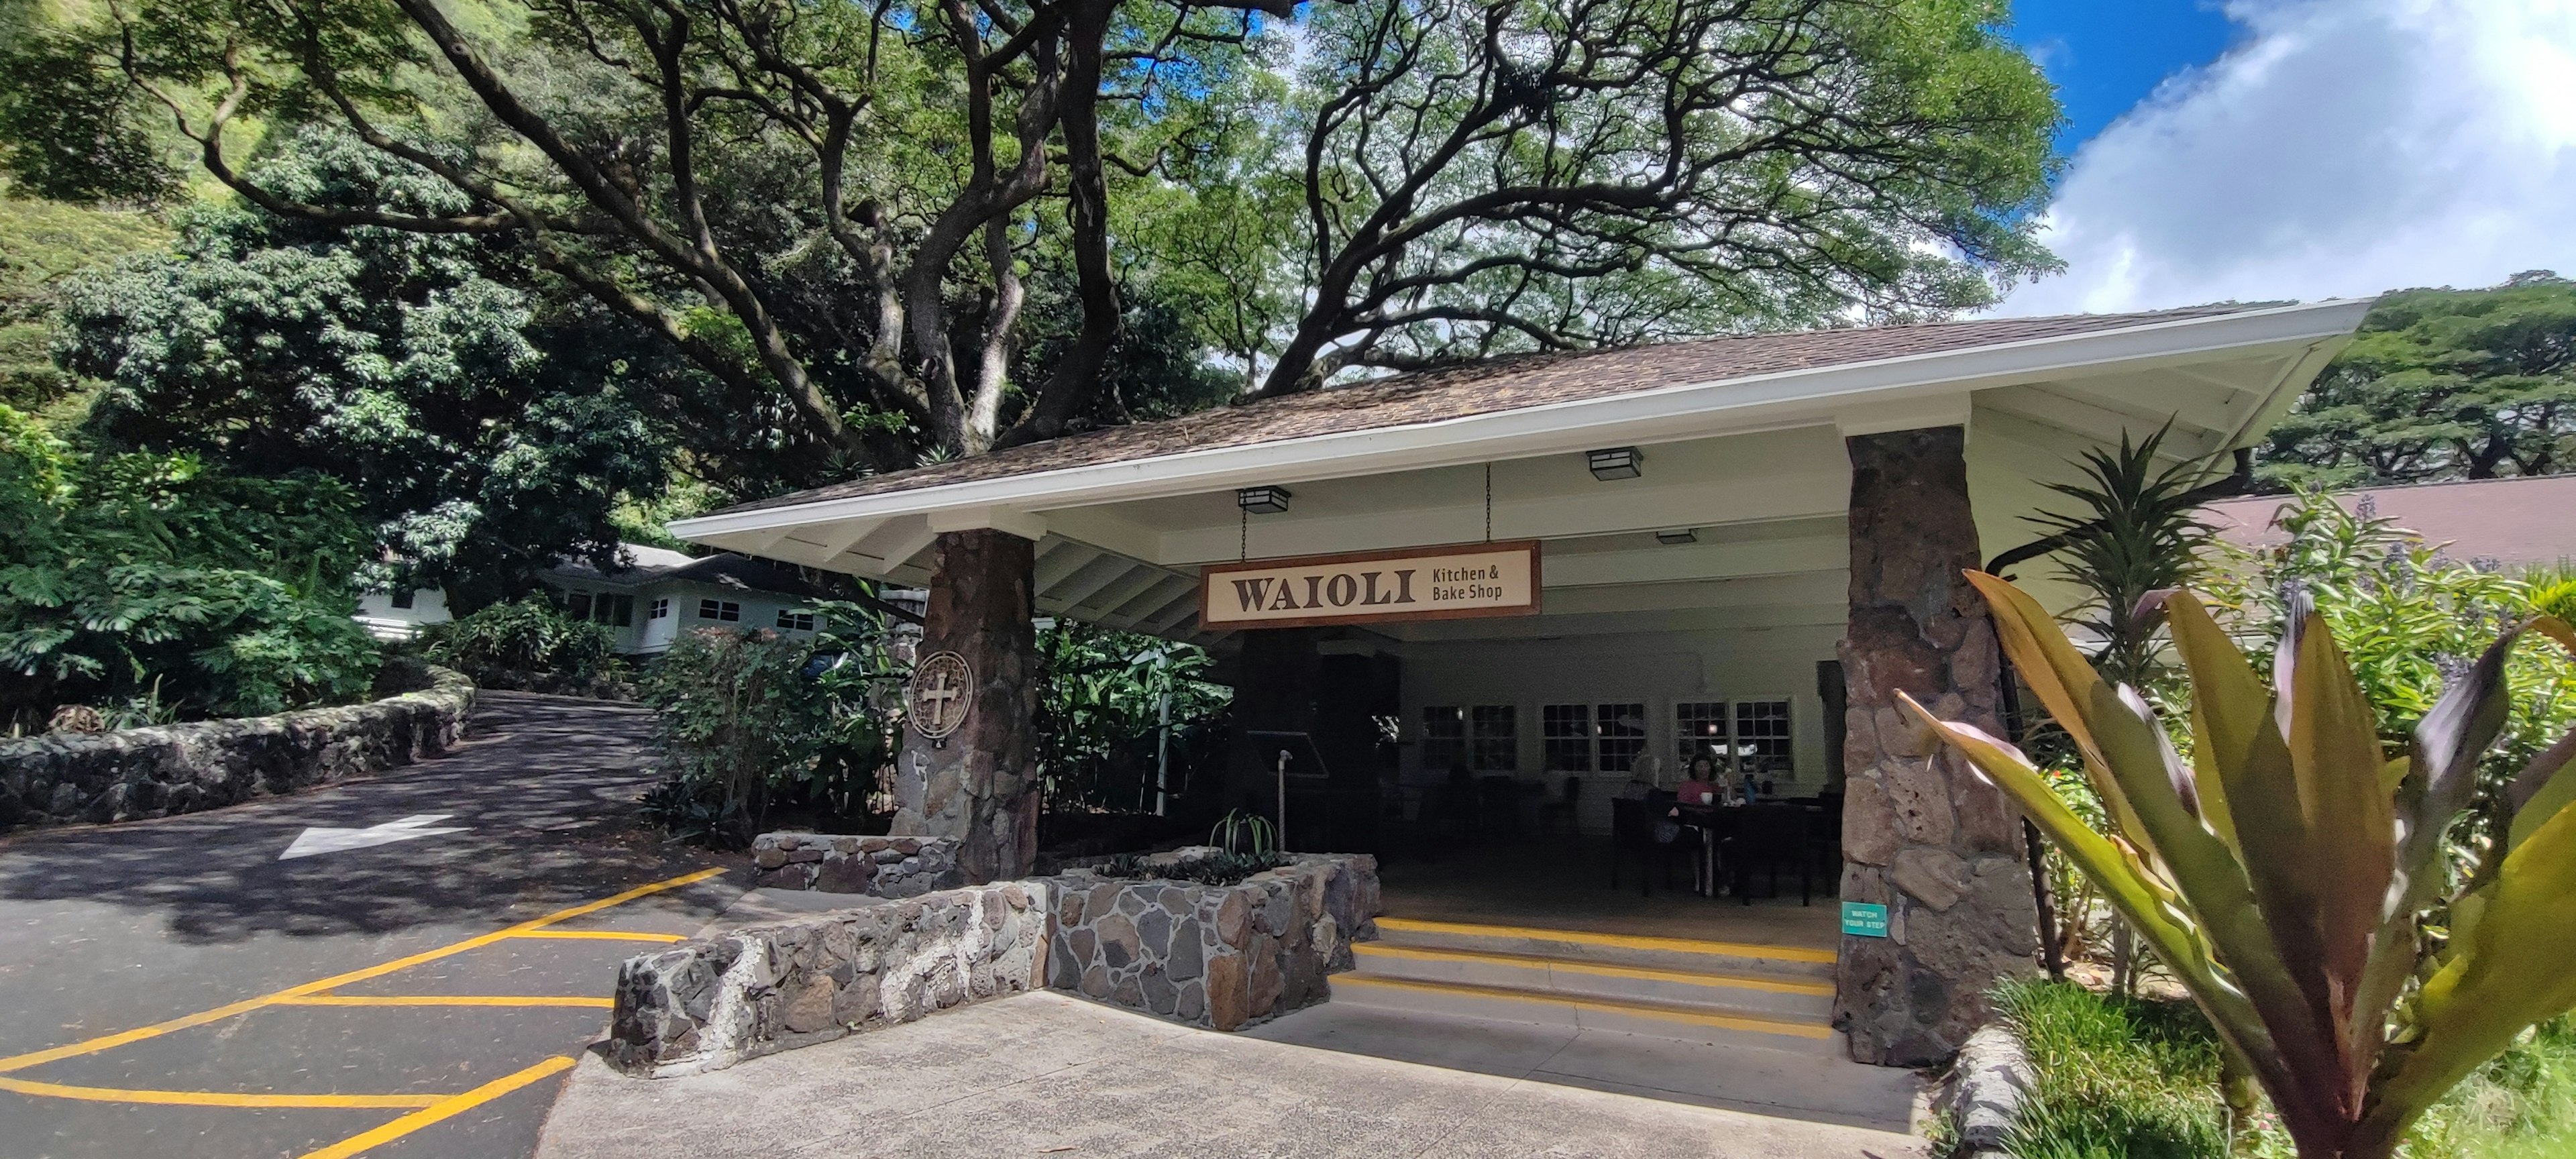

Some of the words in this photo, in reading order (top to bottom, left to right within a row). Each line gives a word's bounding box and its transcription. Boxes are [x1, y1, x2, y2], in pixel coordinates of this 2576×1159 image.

[1433, 567, 1485, 583] Kitchen
[1489, 565, 1499, 580] &
[1231, 569, 1416, 612] WAIOLI
[1433, 586, 1464, 601] Bake
[1469, 584, 1502, 601] Shop
[1851, 910, 1877, 918] WATCH
[1866, 921, 1885, 929] STEP
